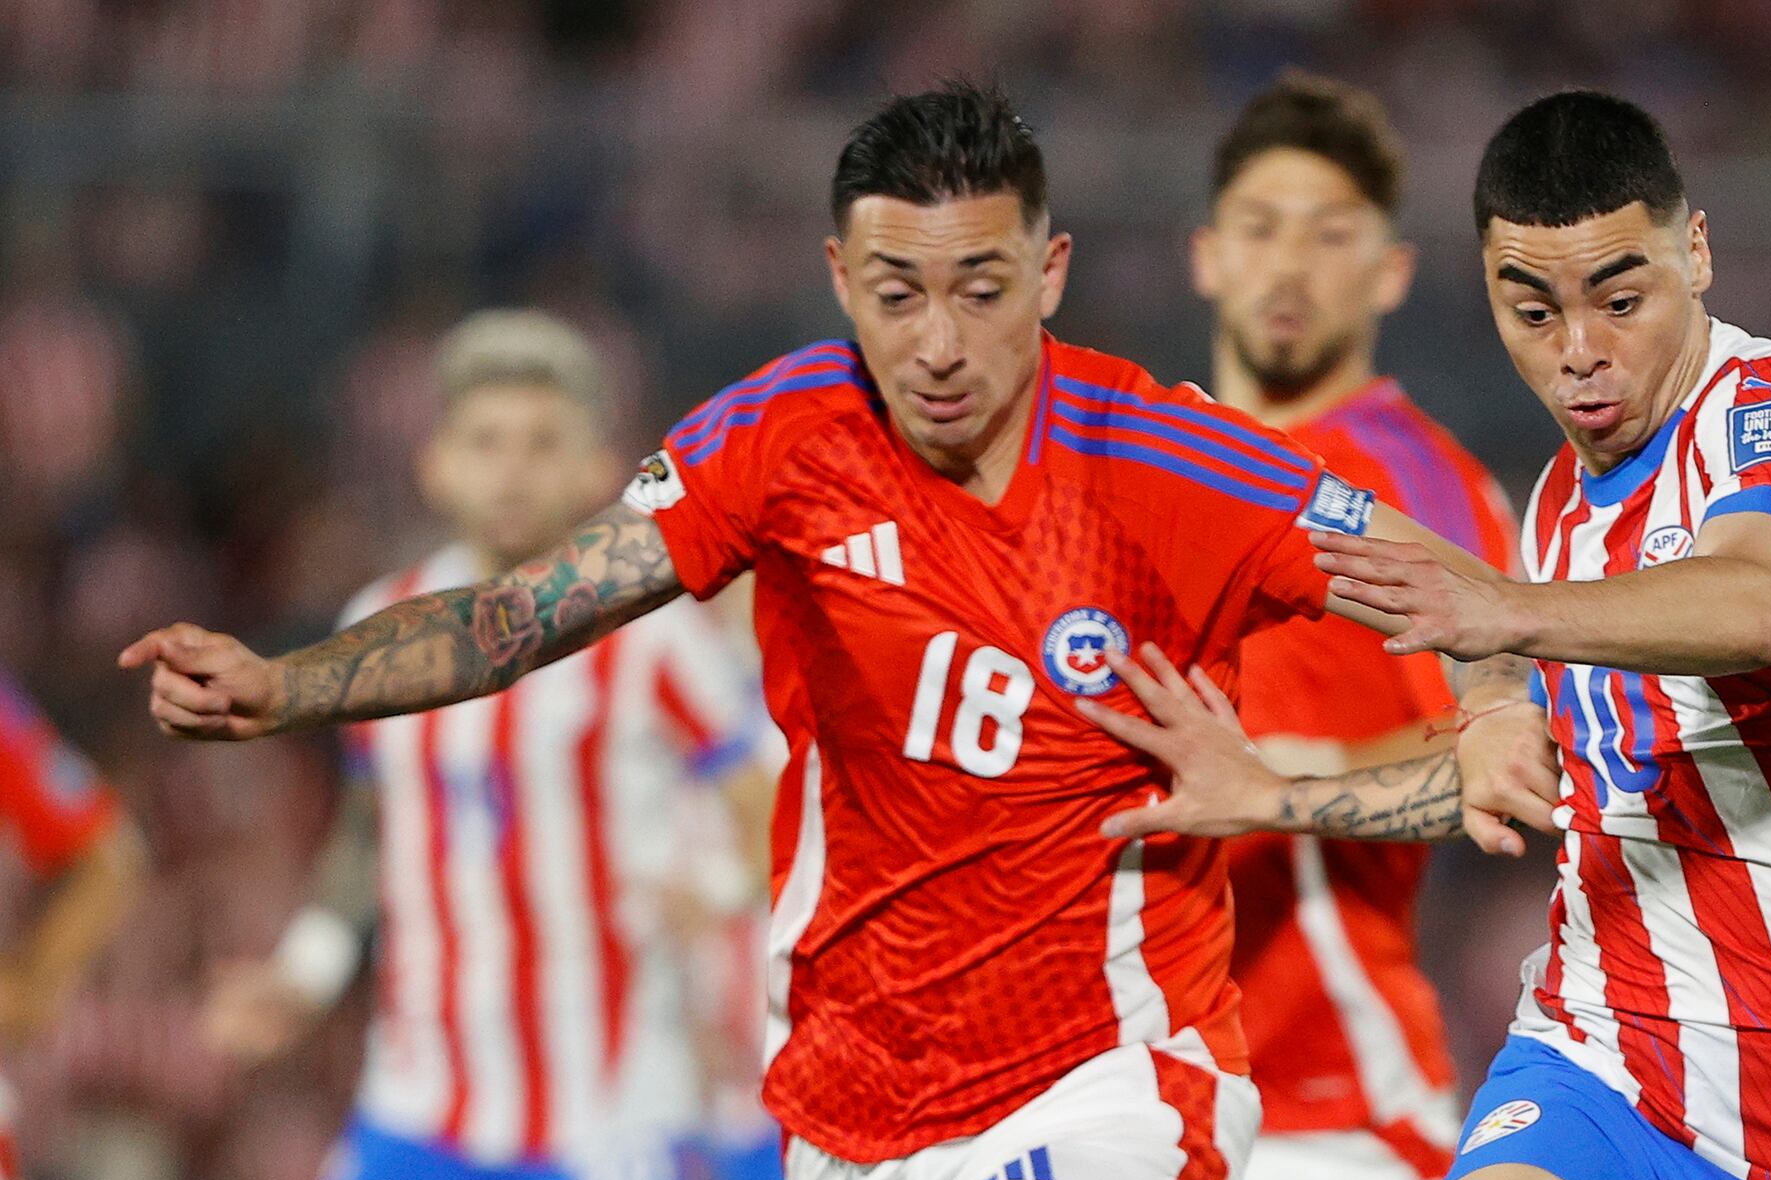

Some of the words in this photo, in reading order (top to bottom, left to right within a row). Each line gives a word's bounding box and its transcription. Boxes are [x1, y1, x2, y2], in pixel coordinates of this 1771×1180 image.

[1653, 531, 1678, 552] APF
[902, 630, 1036, 779] 18
[1556, 665, 1662, 810] 10
